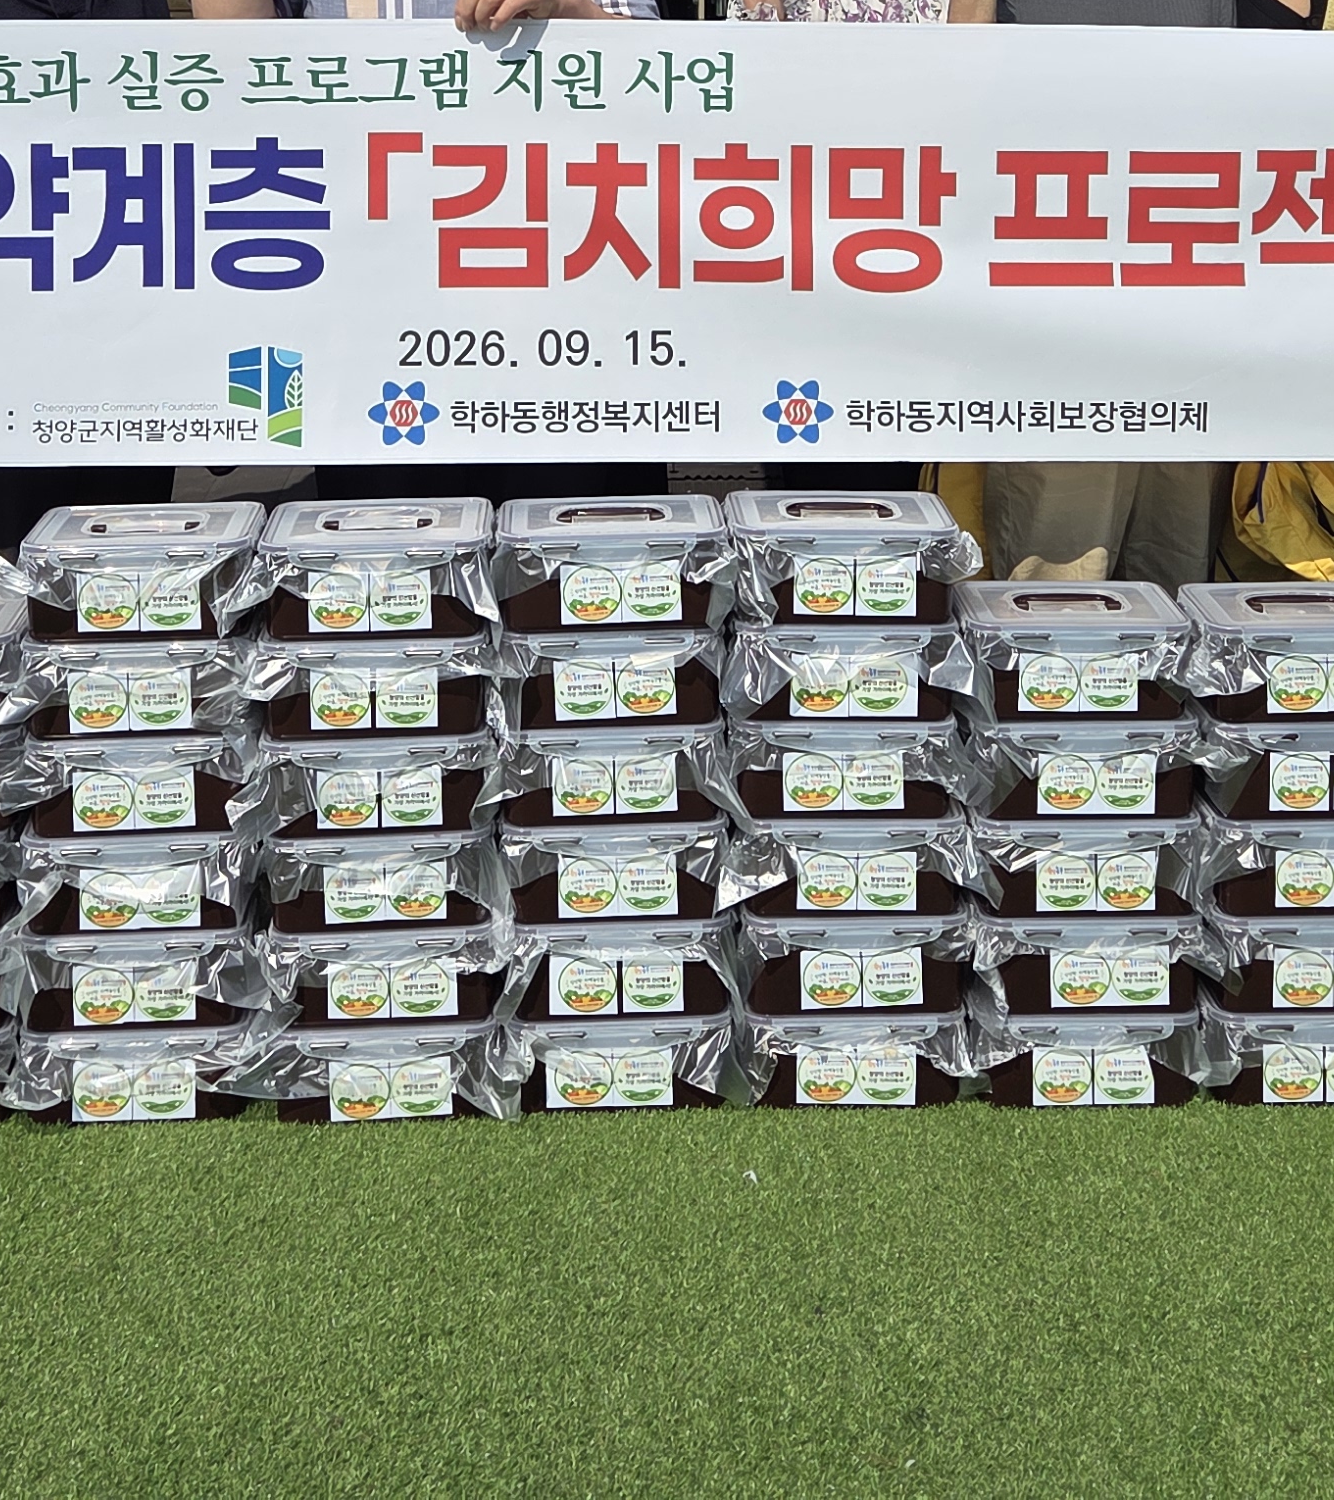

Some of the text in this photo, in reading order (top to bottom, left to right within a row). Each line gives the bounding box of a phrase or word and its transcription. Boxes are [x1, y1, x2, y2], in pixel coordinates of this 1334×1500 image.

[107, 50, 225, 112] 실증
[240, 49, 469, 112] 프로그램
[490, 49, 607, 113] 지원
[624, 50, 734, 114] 사업
[367, 131, 957, 294] 「김치희망
[398, 329, 687, 368] 2026. 09. 15.
[33, 401, 219, 415] Cheongyang Community Foundation
[450, 400, 720, 434] 학하동행정복지센터
[846, 400, 1208, 433] 학하동지역사회보장협의체
[32, 418, 259, 444] 청양군지역활성화재단
